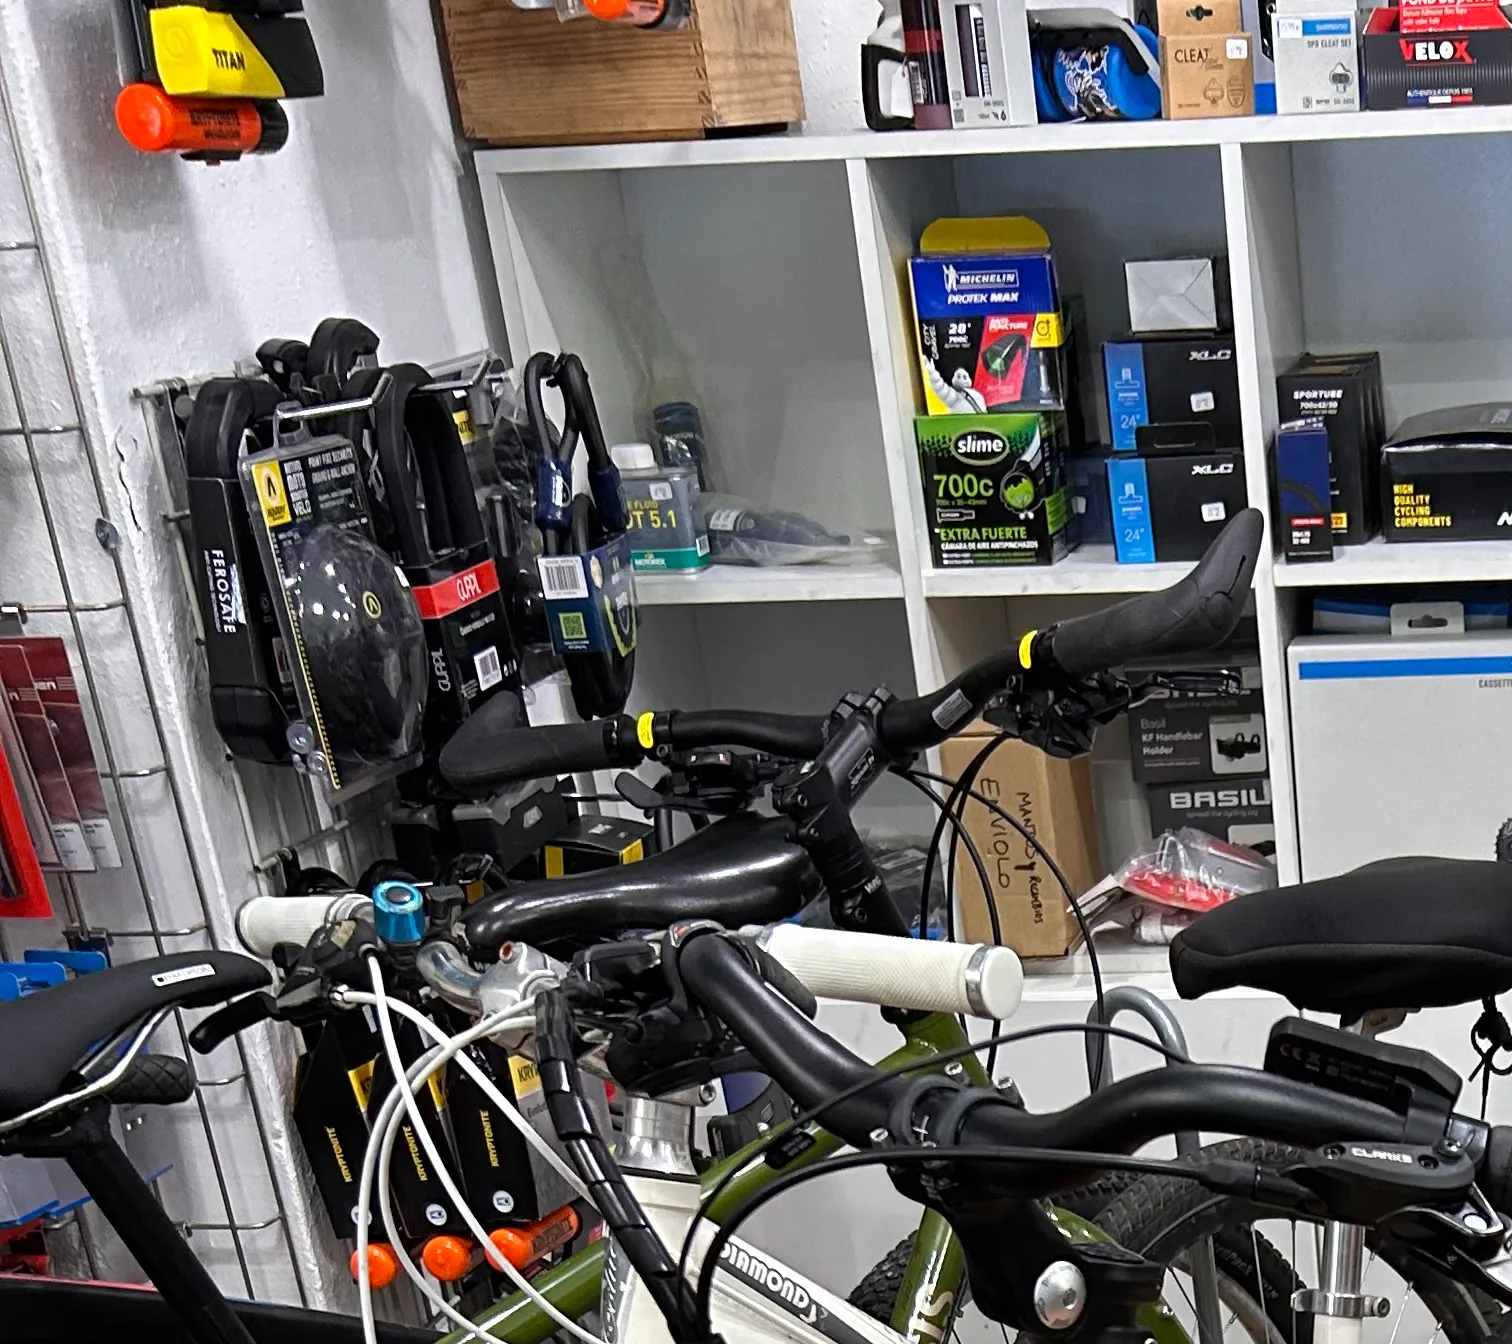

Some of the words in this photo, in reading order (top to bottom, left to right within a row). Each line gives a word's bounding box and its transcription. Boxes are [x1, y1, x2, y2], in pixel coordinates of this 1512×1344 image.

[212, 48, 246, 71] TITAN
[1400, 38, 1475, 65] VELOX
[960, 273, 1015, 284] MICHELIN
[947, 293, 988, 304] PROTEK
[990, 291, 1019, 303] MAX
[1189, 350, 1231, 361] XLC
[957, 435, 1003, 454] slime
[1191, 463, 1234, 475] XLC
[933, 473, 994, 498] 700c
[1394, 495, 1431, 505] QUALITY
[626, 511, 644, 529] OT
[650, 509, 677, 529] 5.1
[1394, 506, 1431, 516] CYCLING
[1395, 516, 1452, 528] COMPONENTS
[940, 528, 980, 541] EXTRA
[982, 527, 1027, 540] FUERTE
[1124, 527, 1145, 543] 24"
[211, 549, 237, 634] FEROSAFE
[1156, 732, 1203, 742] Handlebar
[1143, 746, 1174, 756] Holder
[1170, 787, 1271, 809] BASIL
[479, 1109, 500, 1167] KRYPTONITE
[325, 1125, 352, 1183] KRYPTONITE
[402, 1125, 428, 1182] KRYPTONITE
